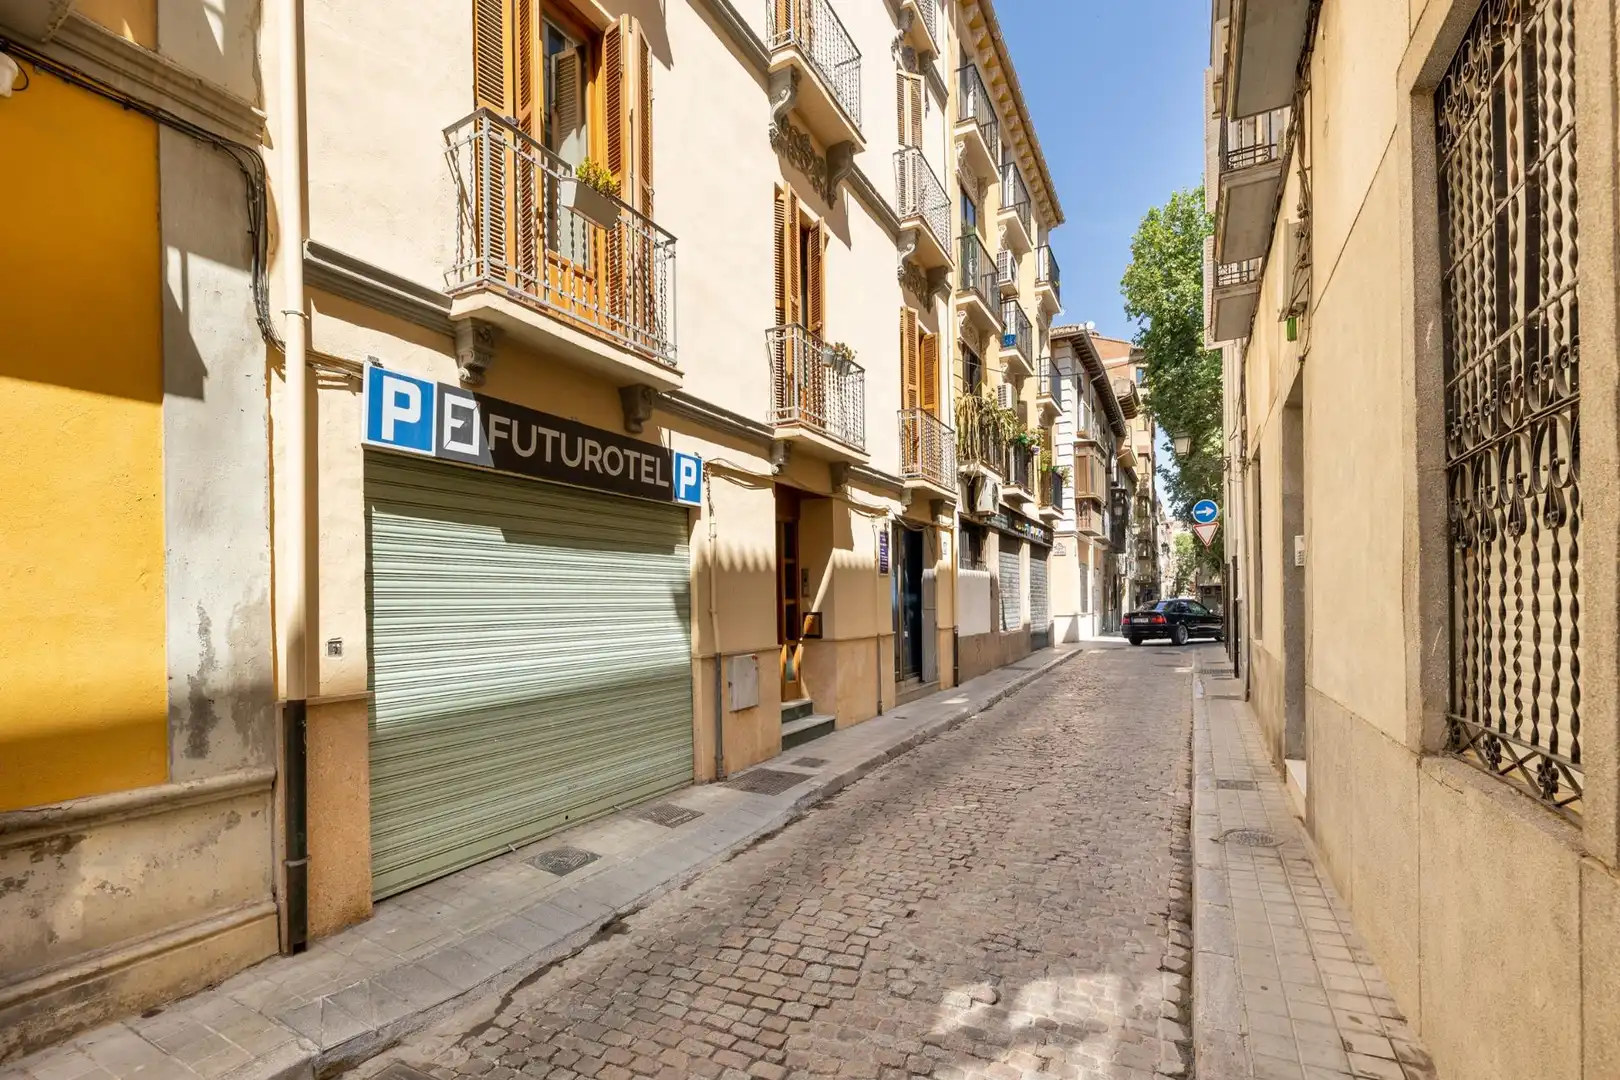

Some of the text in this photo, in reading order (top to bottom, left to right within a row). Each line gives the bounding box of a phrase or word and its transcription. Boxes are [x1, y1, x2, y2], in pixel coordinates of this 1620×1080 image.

[381, 375, 422, 441] P
[488, 413, 670, 488] FUTUROTEL
[679, 458, 697, 499] P
